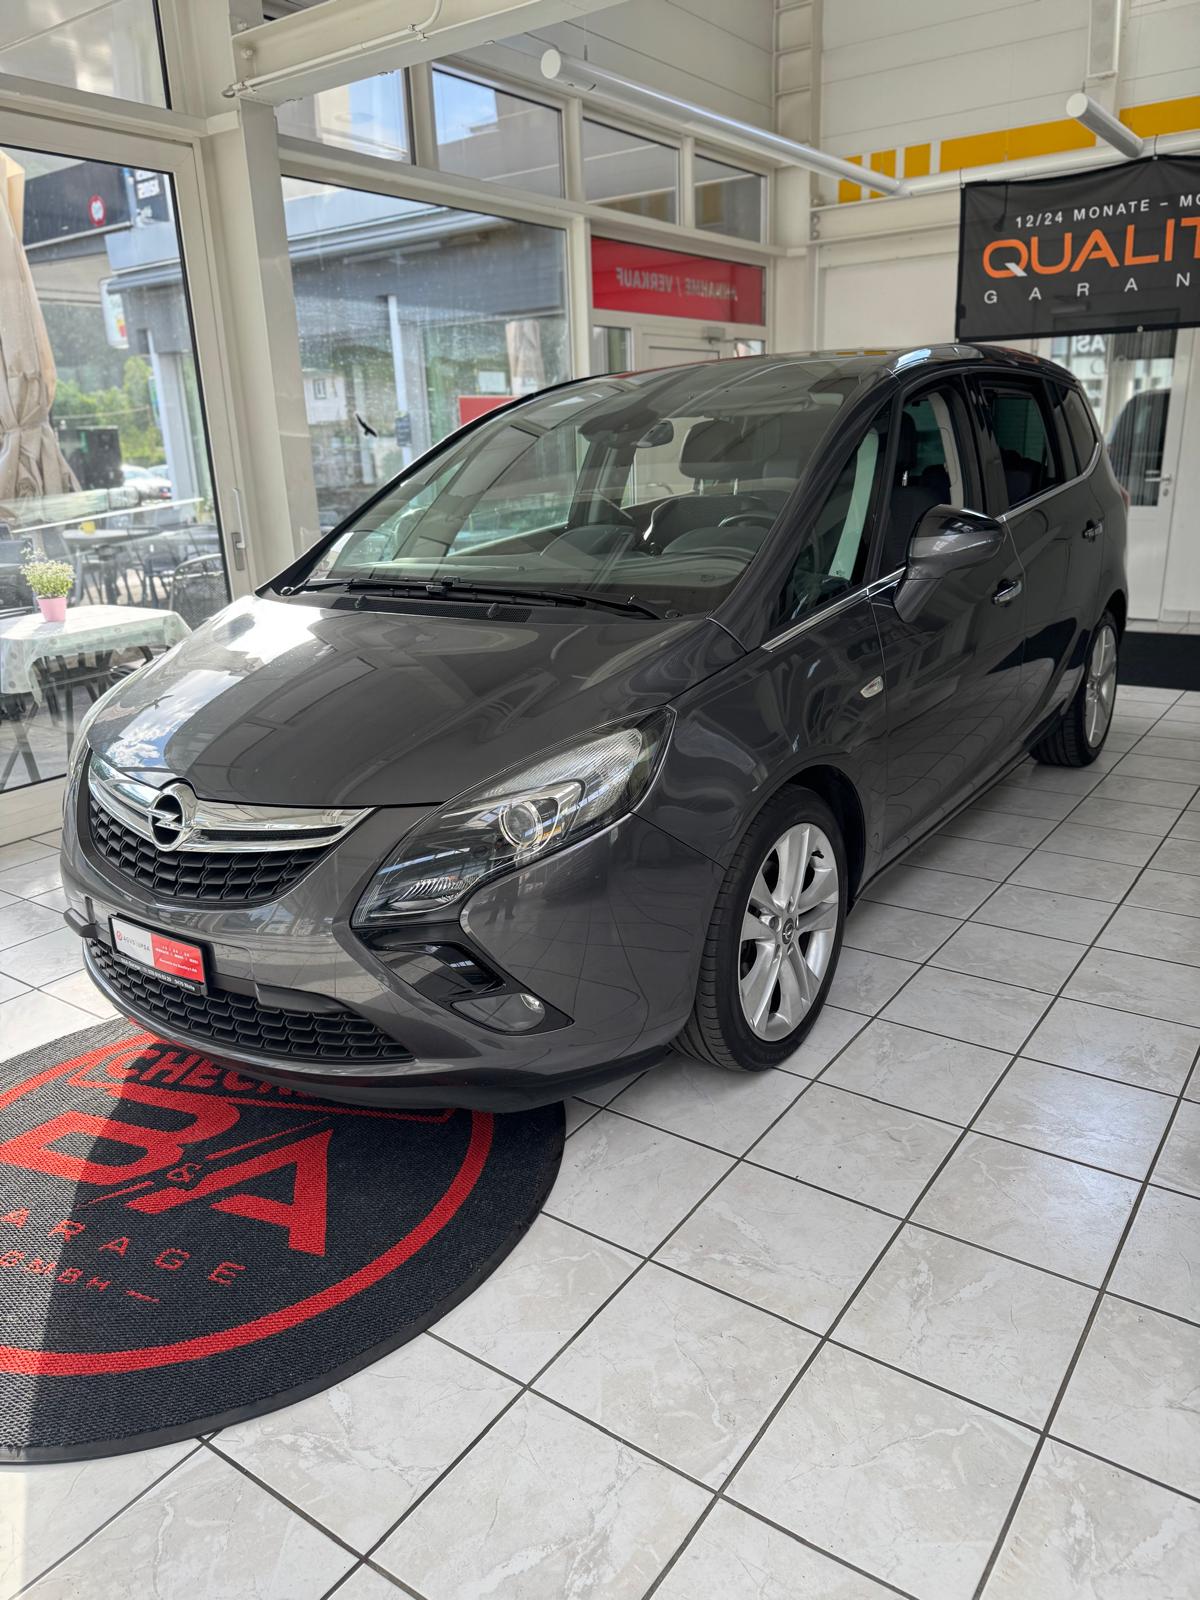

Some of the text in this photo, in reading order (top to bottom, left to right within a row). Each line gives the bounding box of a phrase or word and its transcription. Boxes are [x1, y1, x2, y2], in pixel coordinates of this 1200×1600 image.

[1015, 211, 1063, 229] 12/24
[1073, 199, 1150, 221] MONATE
[984, 272, 1191, 304] GARAN
[104, 1048, 320, 1099] CHEC
[0, 1207, 246, 1286] ARAGE
